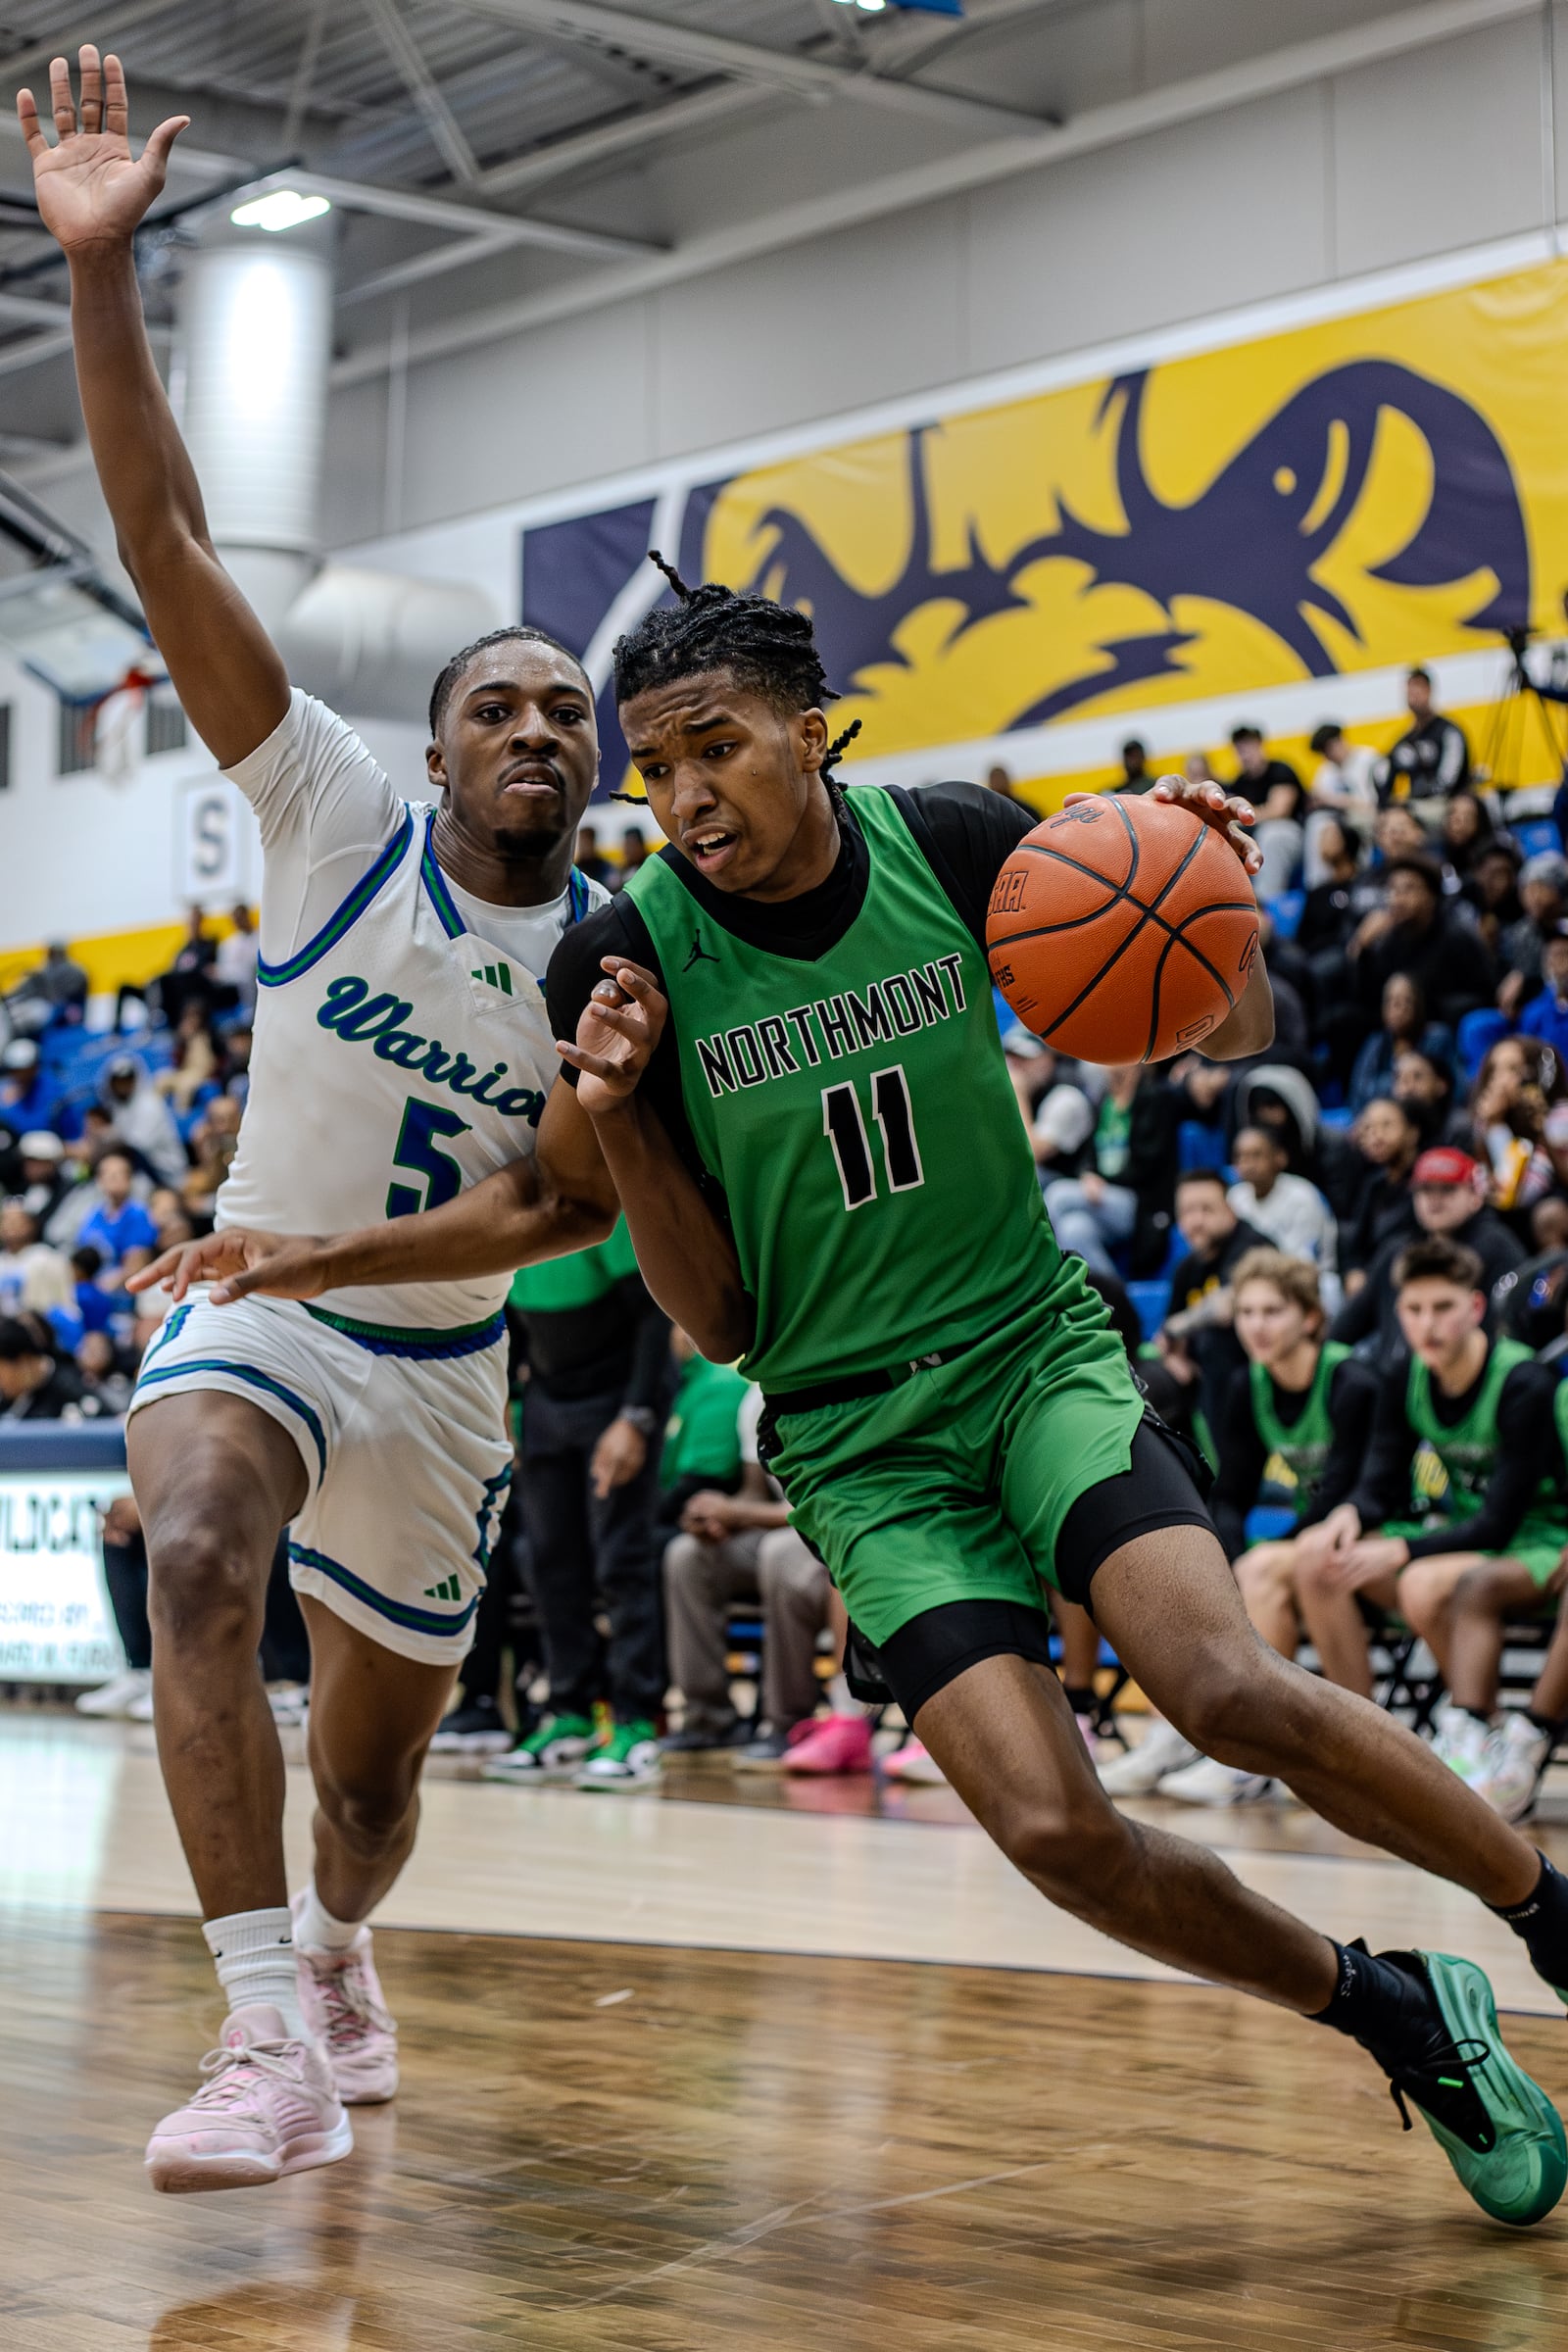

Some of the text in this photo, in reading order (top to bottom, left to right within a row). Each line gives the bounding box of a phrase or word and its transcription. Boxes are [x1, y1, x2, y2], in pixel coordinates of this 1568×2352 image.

[695, 953, 968, 1098] NORTHMONT
[385, 1096, 473, 1220] 5
[820, 1063, 925, 1212] 11
